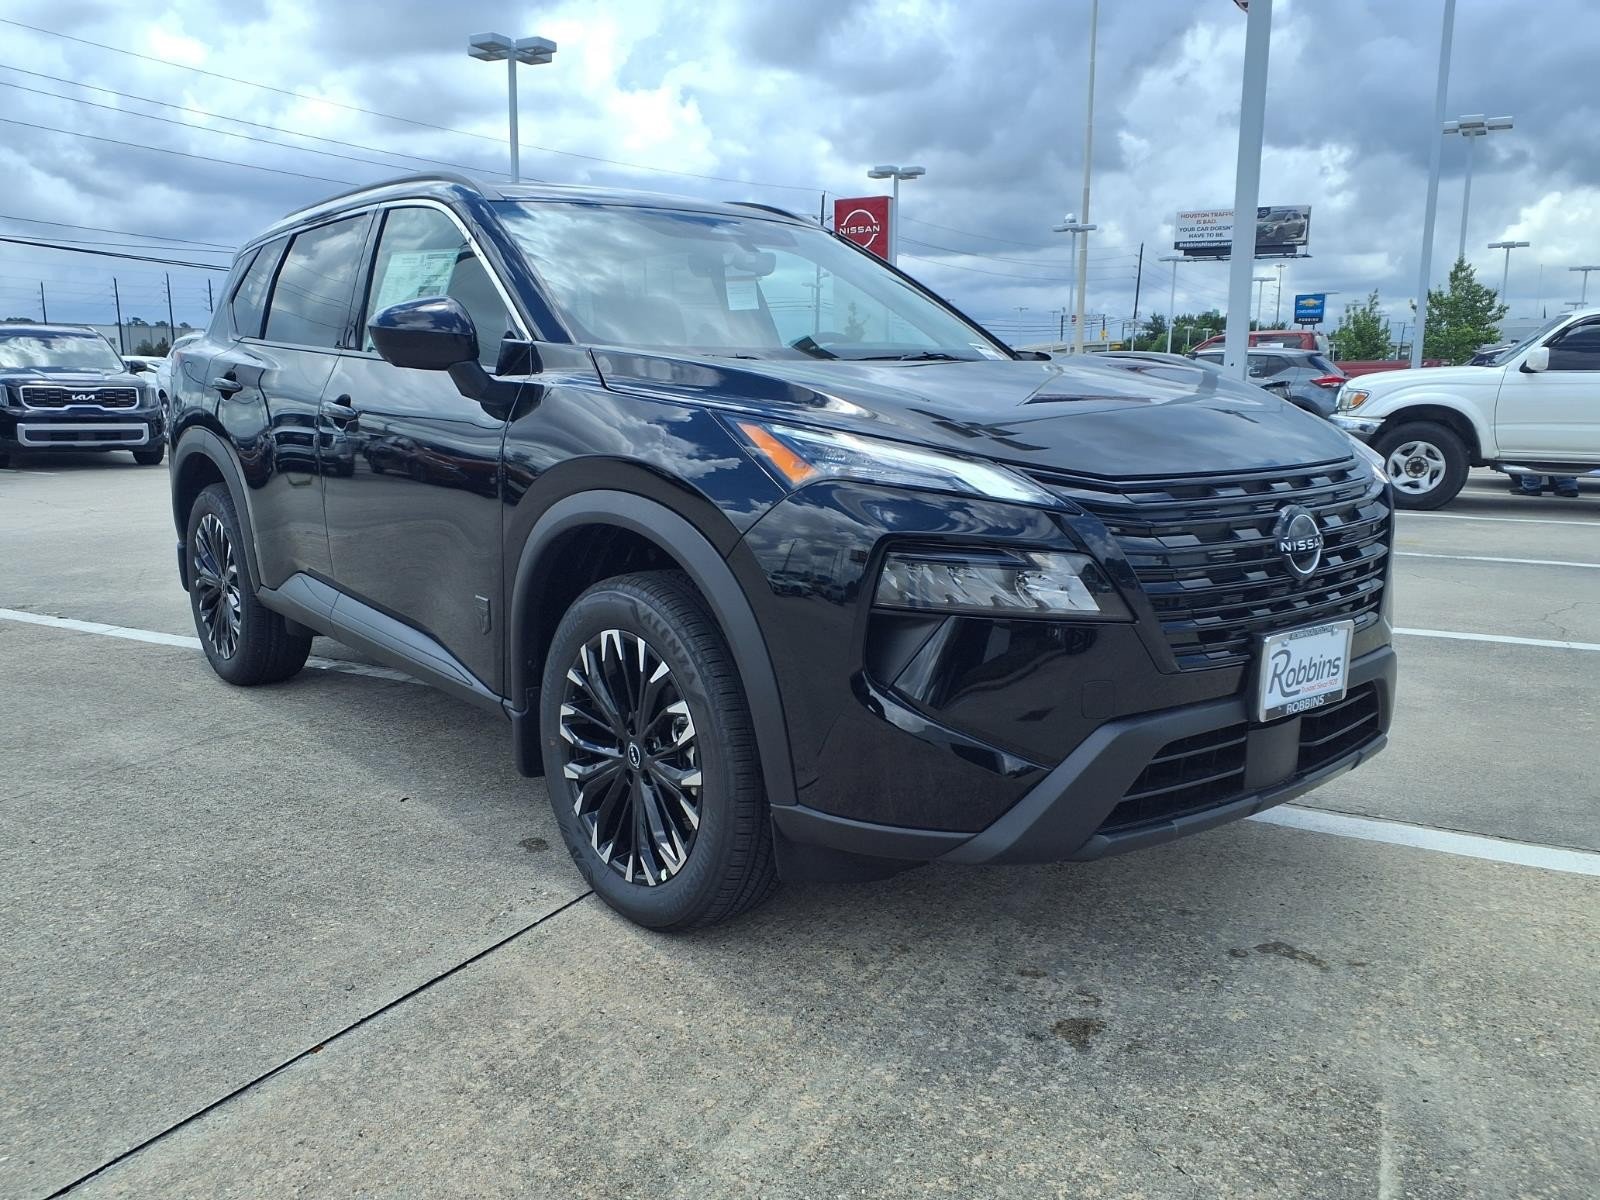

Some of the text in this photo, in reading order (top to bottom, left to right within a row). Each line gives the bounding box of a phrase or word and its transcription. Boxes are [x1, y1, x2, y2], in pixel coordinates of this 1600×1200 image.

[839, 225, 880, 234] NISSAN
[1268, 649, 1341, 698] Robbins
[1286, 694, 1325, 715] ROBBINS
